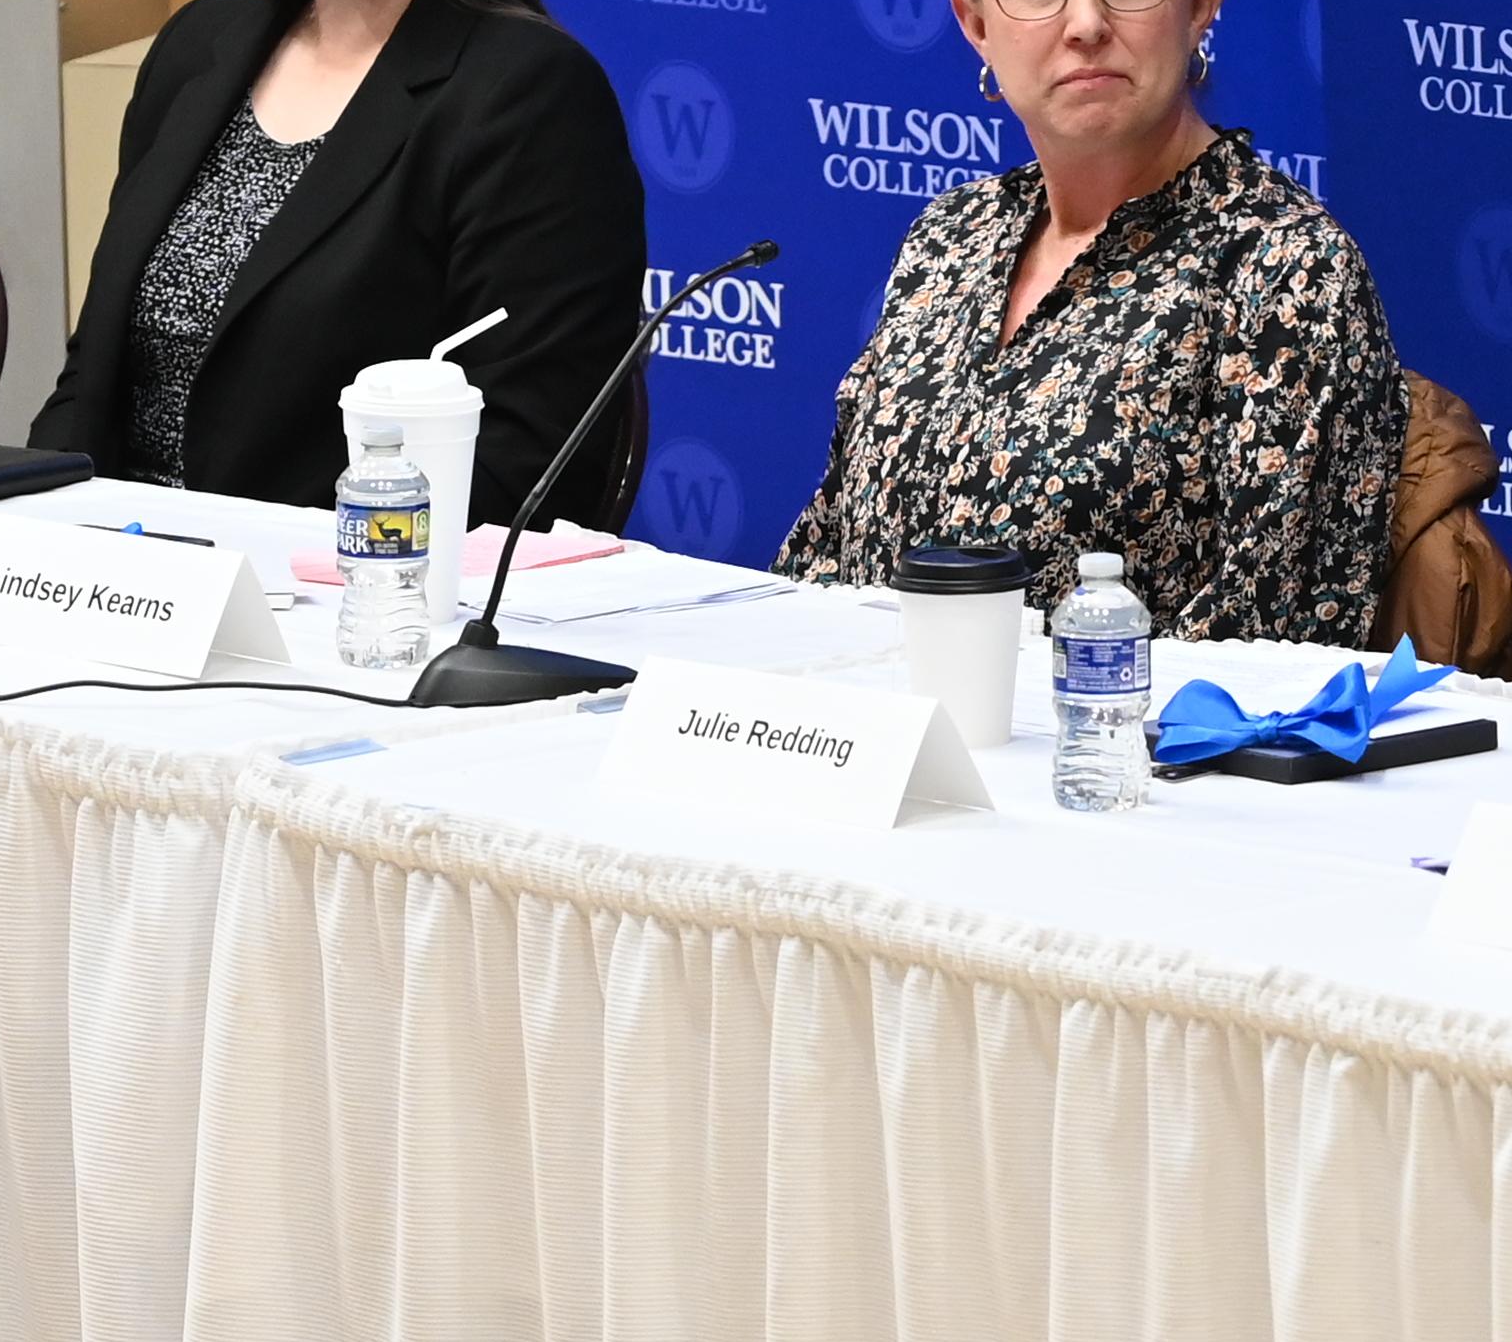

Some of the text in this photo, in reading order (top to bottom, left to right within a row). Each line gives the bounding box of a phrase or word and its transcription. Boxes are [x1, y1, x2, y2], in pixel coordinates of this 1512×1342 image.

[808, 98, 1004, 163] WILSON
[88, 584, 174, 622] Kearns
[678, 709, 854, 768] Julie Redding
